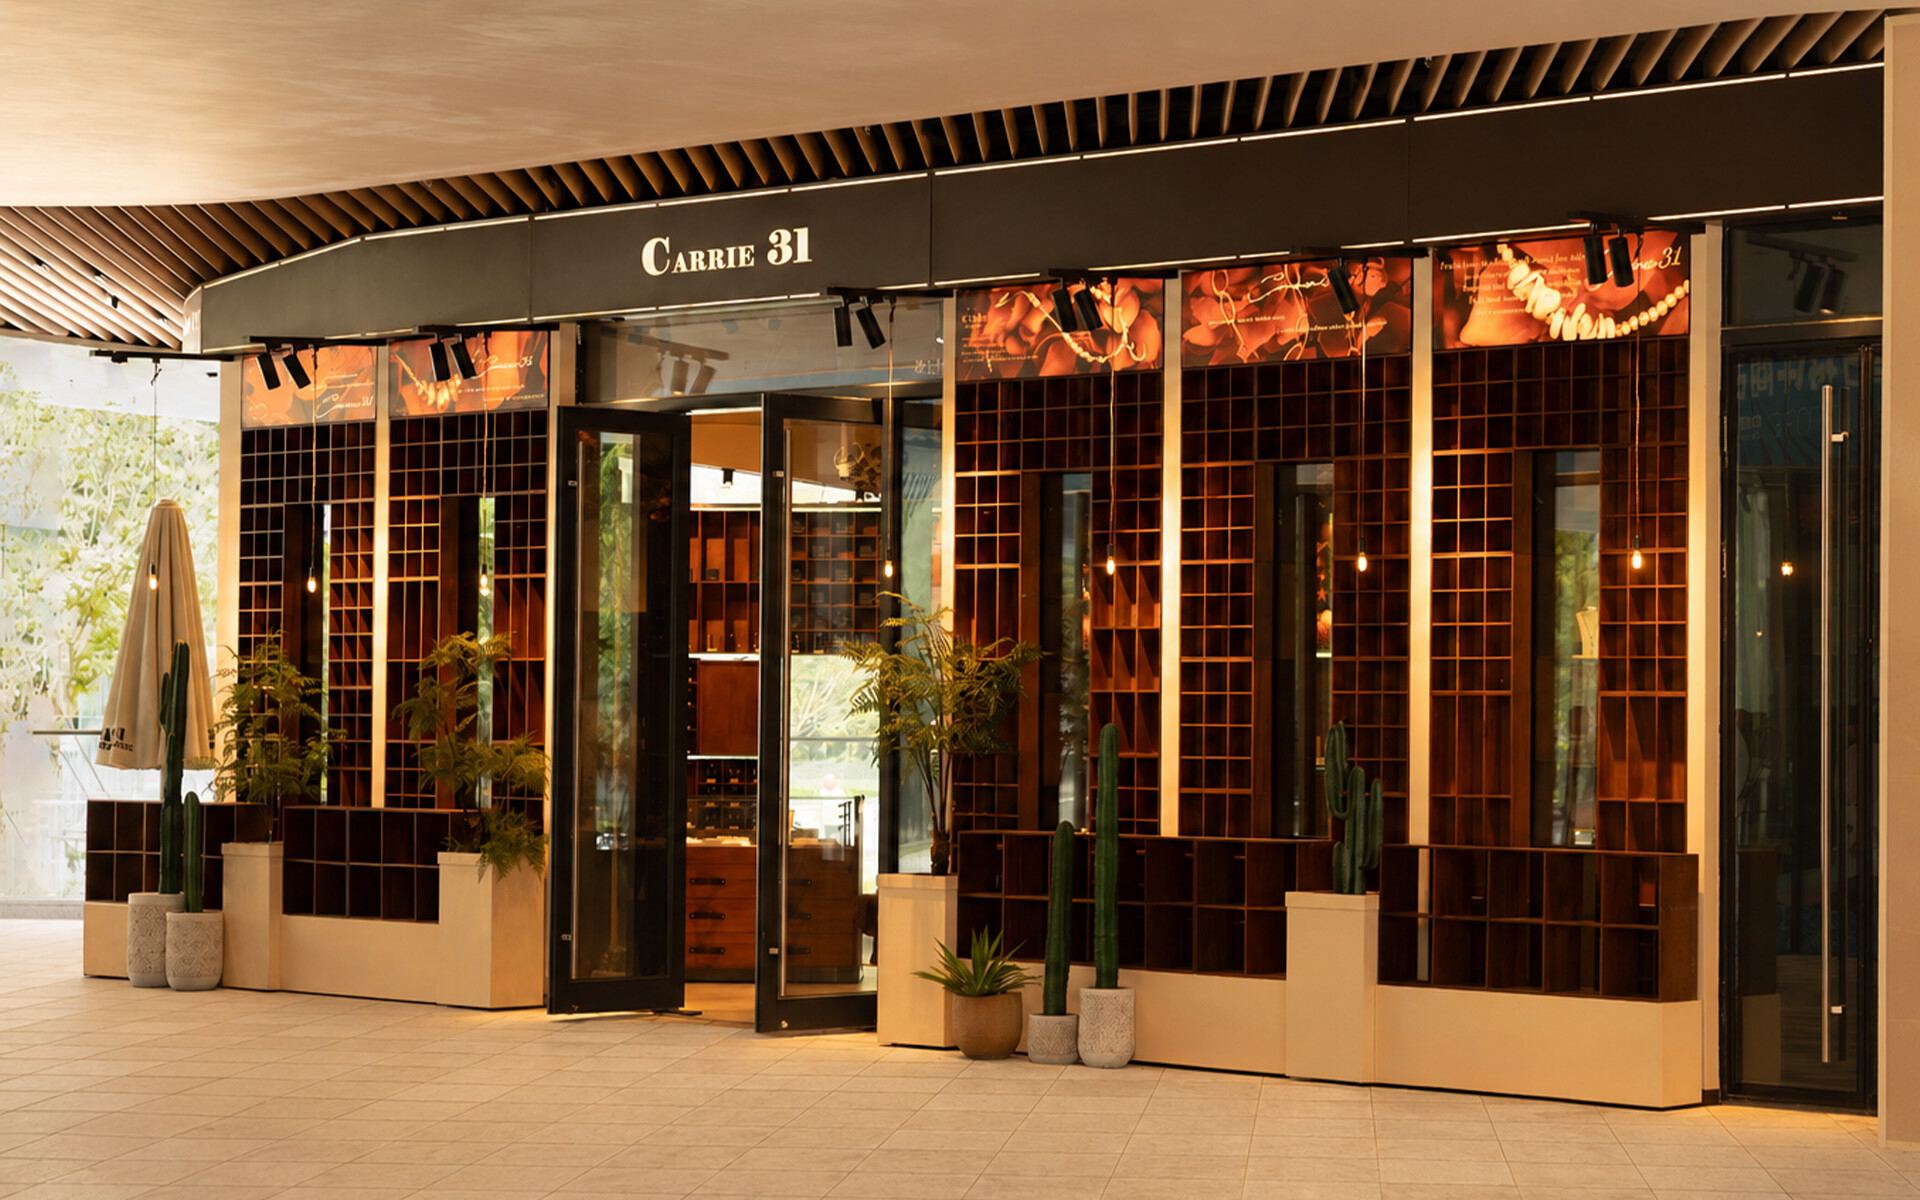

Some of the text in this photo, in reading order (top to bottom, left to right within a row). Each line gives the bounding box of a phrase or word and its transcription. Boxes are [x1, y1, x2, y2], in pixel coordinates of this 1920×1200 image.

[641, 227, 812, 276] CARRIE 31
[1658, 246, 1682, 269] 31
